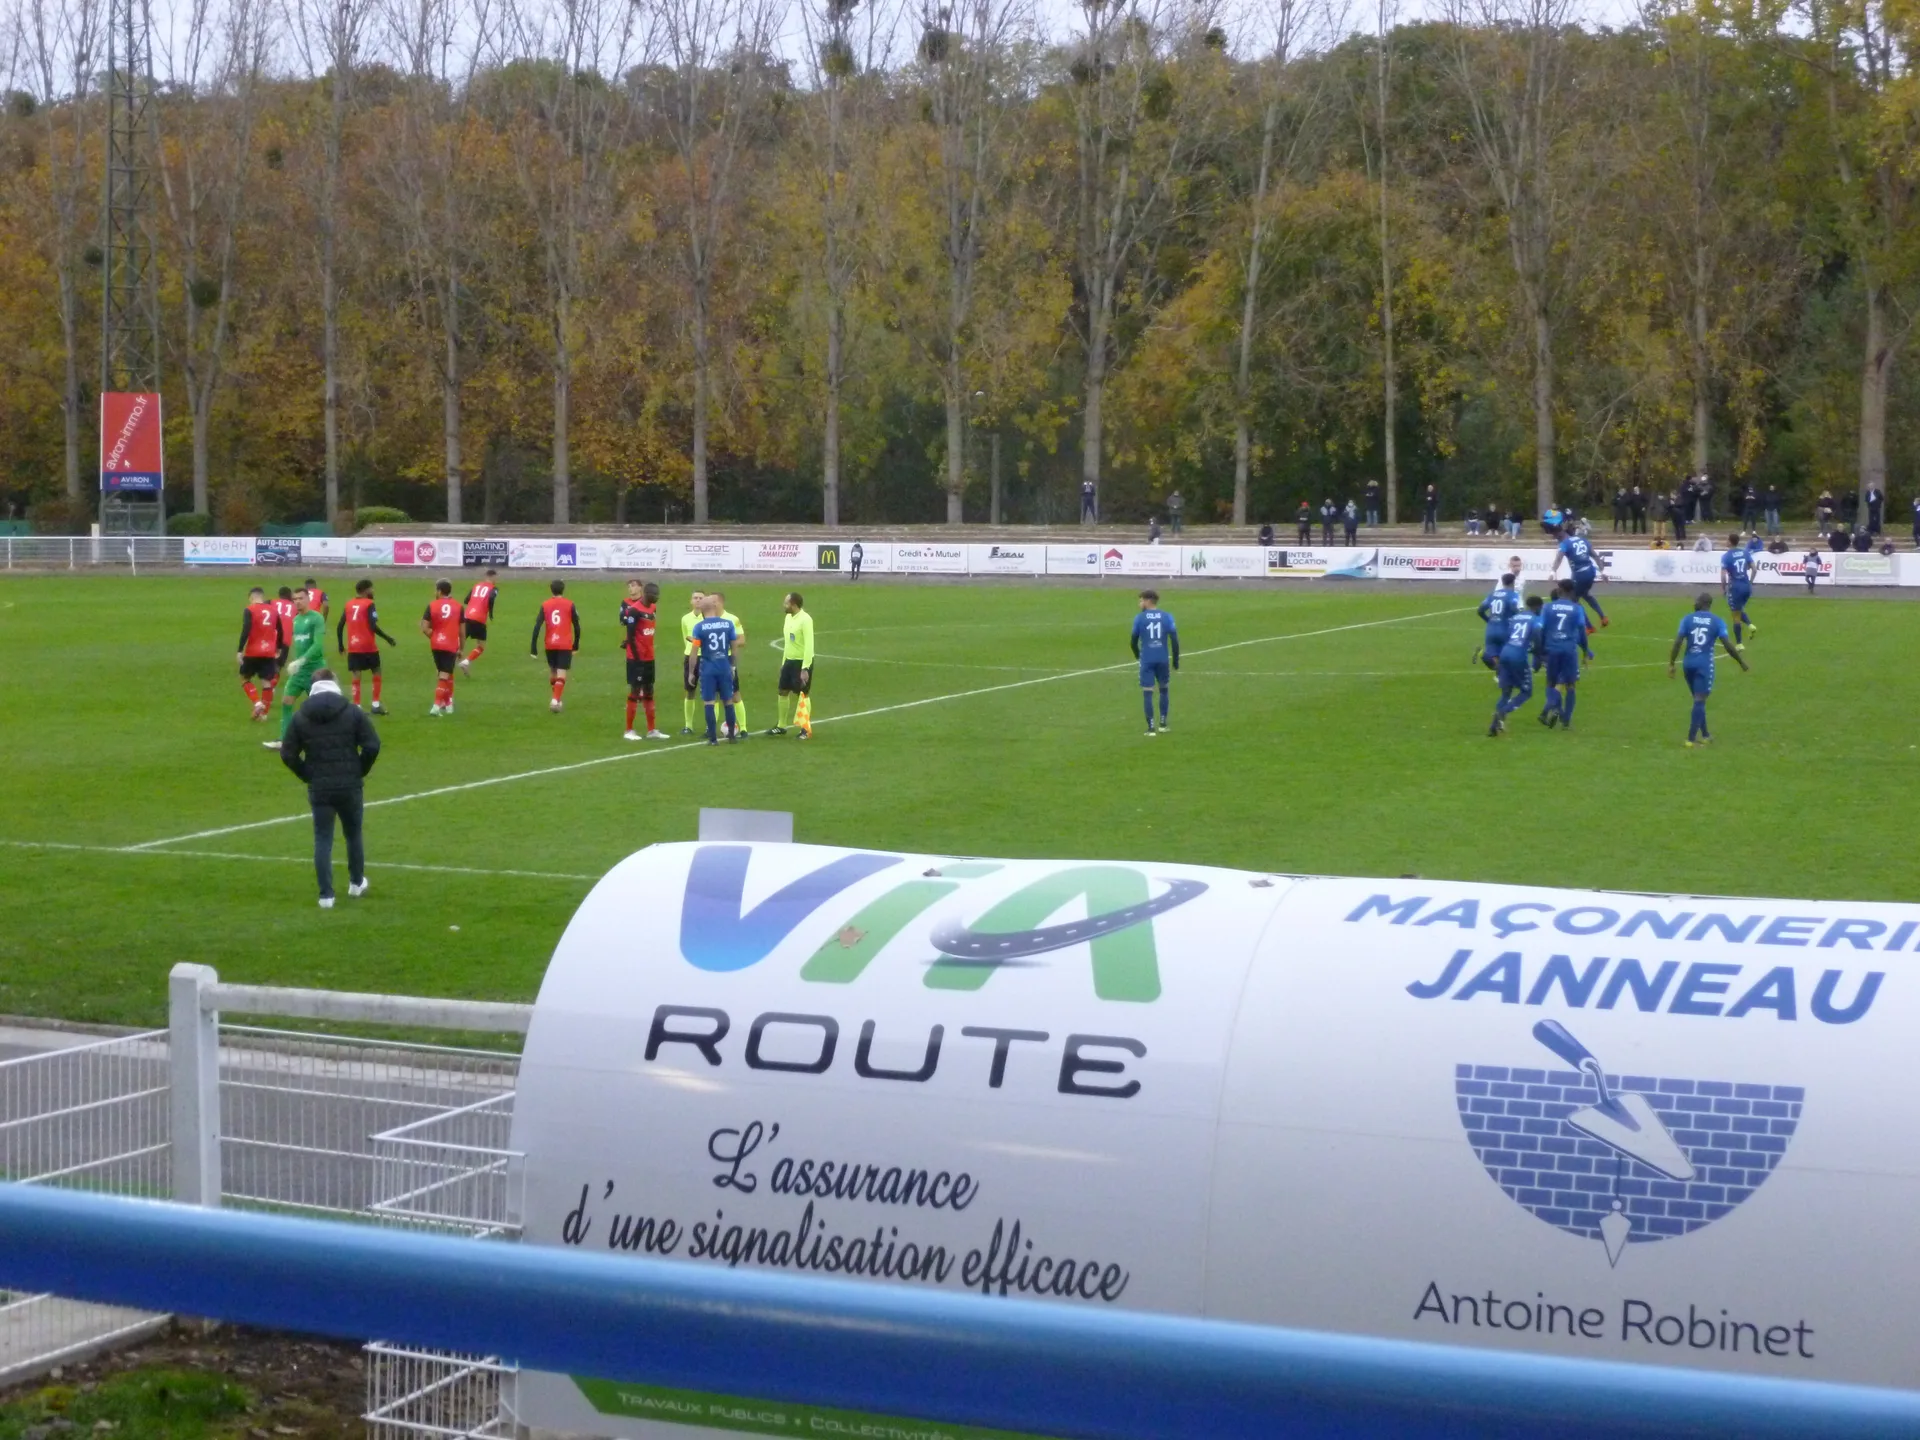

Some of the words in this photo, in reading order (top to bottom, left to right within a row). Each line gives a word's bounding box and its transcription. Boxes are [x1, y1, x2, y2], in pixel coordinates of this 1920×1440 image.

[107, 395, 148, 470] aviron-immo.fr
[935, 550, 961, 558] Mutuel
[1572, 540, 1588, 555] 25
[557, 554, 574, 564] AXA
[1104, 560, 1122, 568] ERA
[1733, 558, 1746, 573] 17
[473, 585, 489, 598] 10
[276, 602, 292, 617] 11
[352, 605, 360, 621] 7
[441, 603, 451, 619] 9
[1490, 599, 1503, 615] 10
[262, 609, 271, 626] 2
[551, 609, 561, 625] 6
[1556, 613, 1567, 631] 7
[1146, 621, 1162, 639] 11
[1510, 622, 1528, 639] 21
[1690, 627, 1709, 645] 15
[708, 632, 727, 651] 31
[1343, 893, 1920, 952] MAÇONNERI
[1405, 949, 1886, 1025] JANNEAU
[644, 1003, 1148, 1099] ROUTE
[708, 1120, 980, 1211] L'assurance
[562, 1180, 684, 1249] d'une
[688, 1199, 956, 1282] signalisation
[960, 1217, 1130, 1300] efficace
[1413, 1281, 1606, 1339] Antoine
[1620, 1299, 1816, 1359] Robinet
